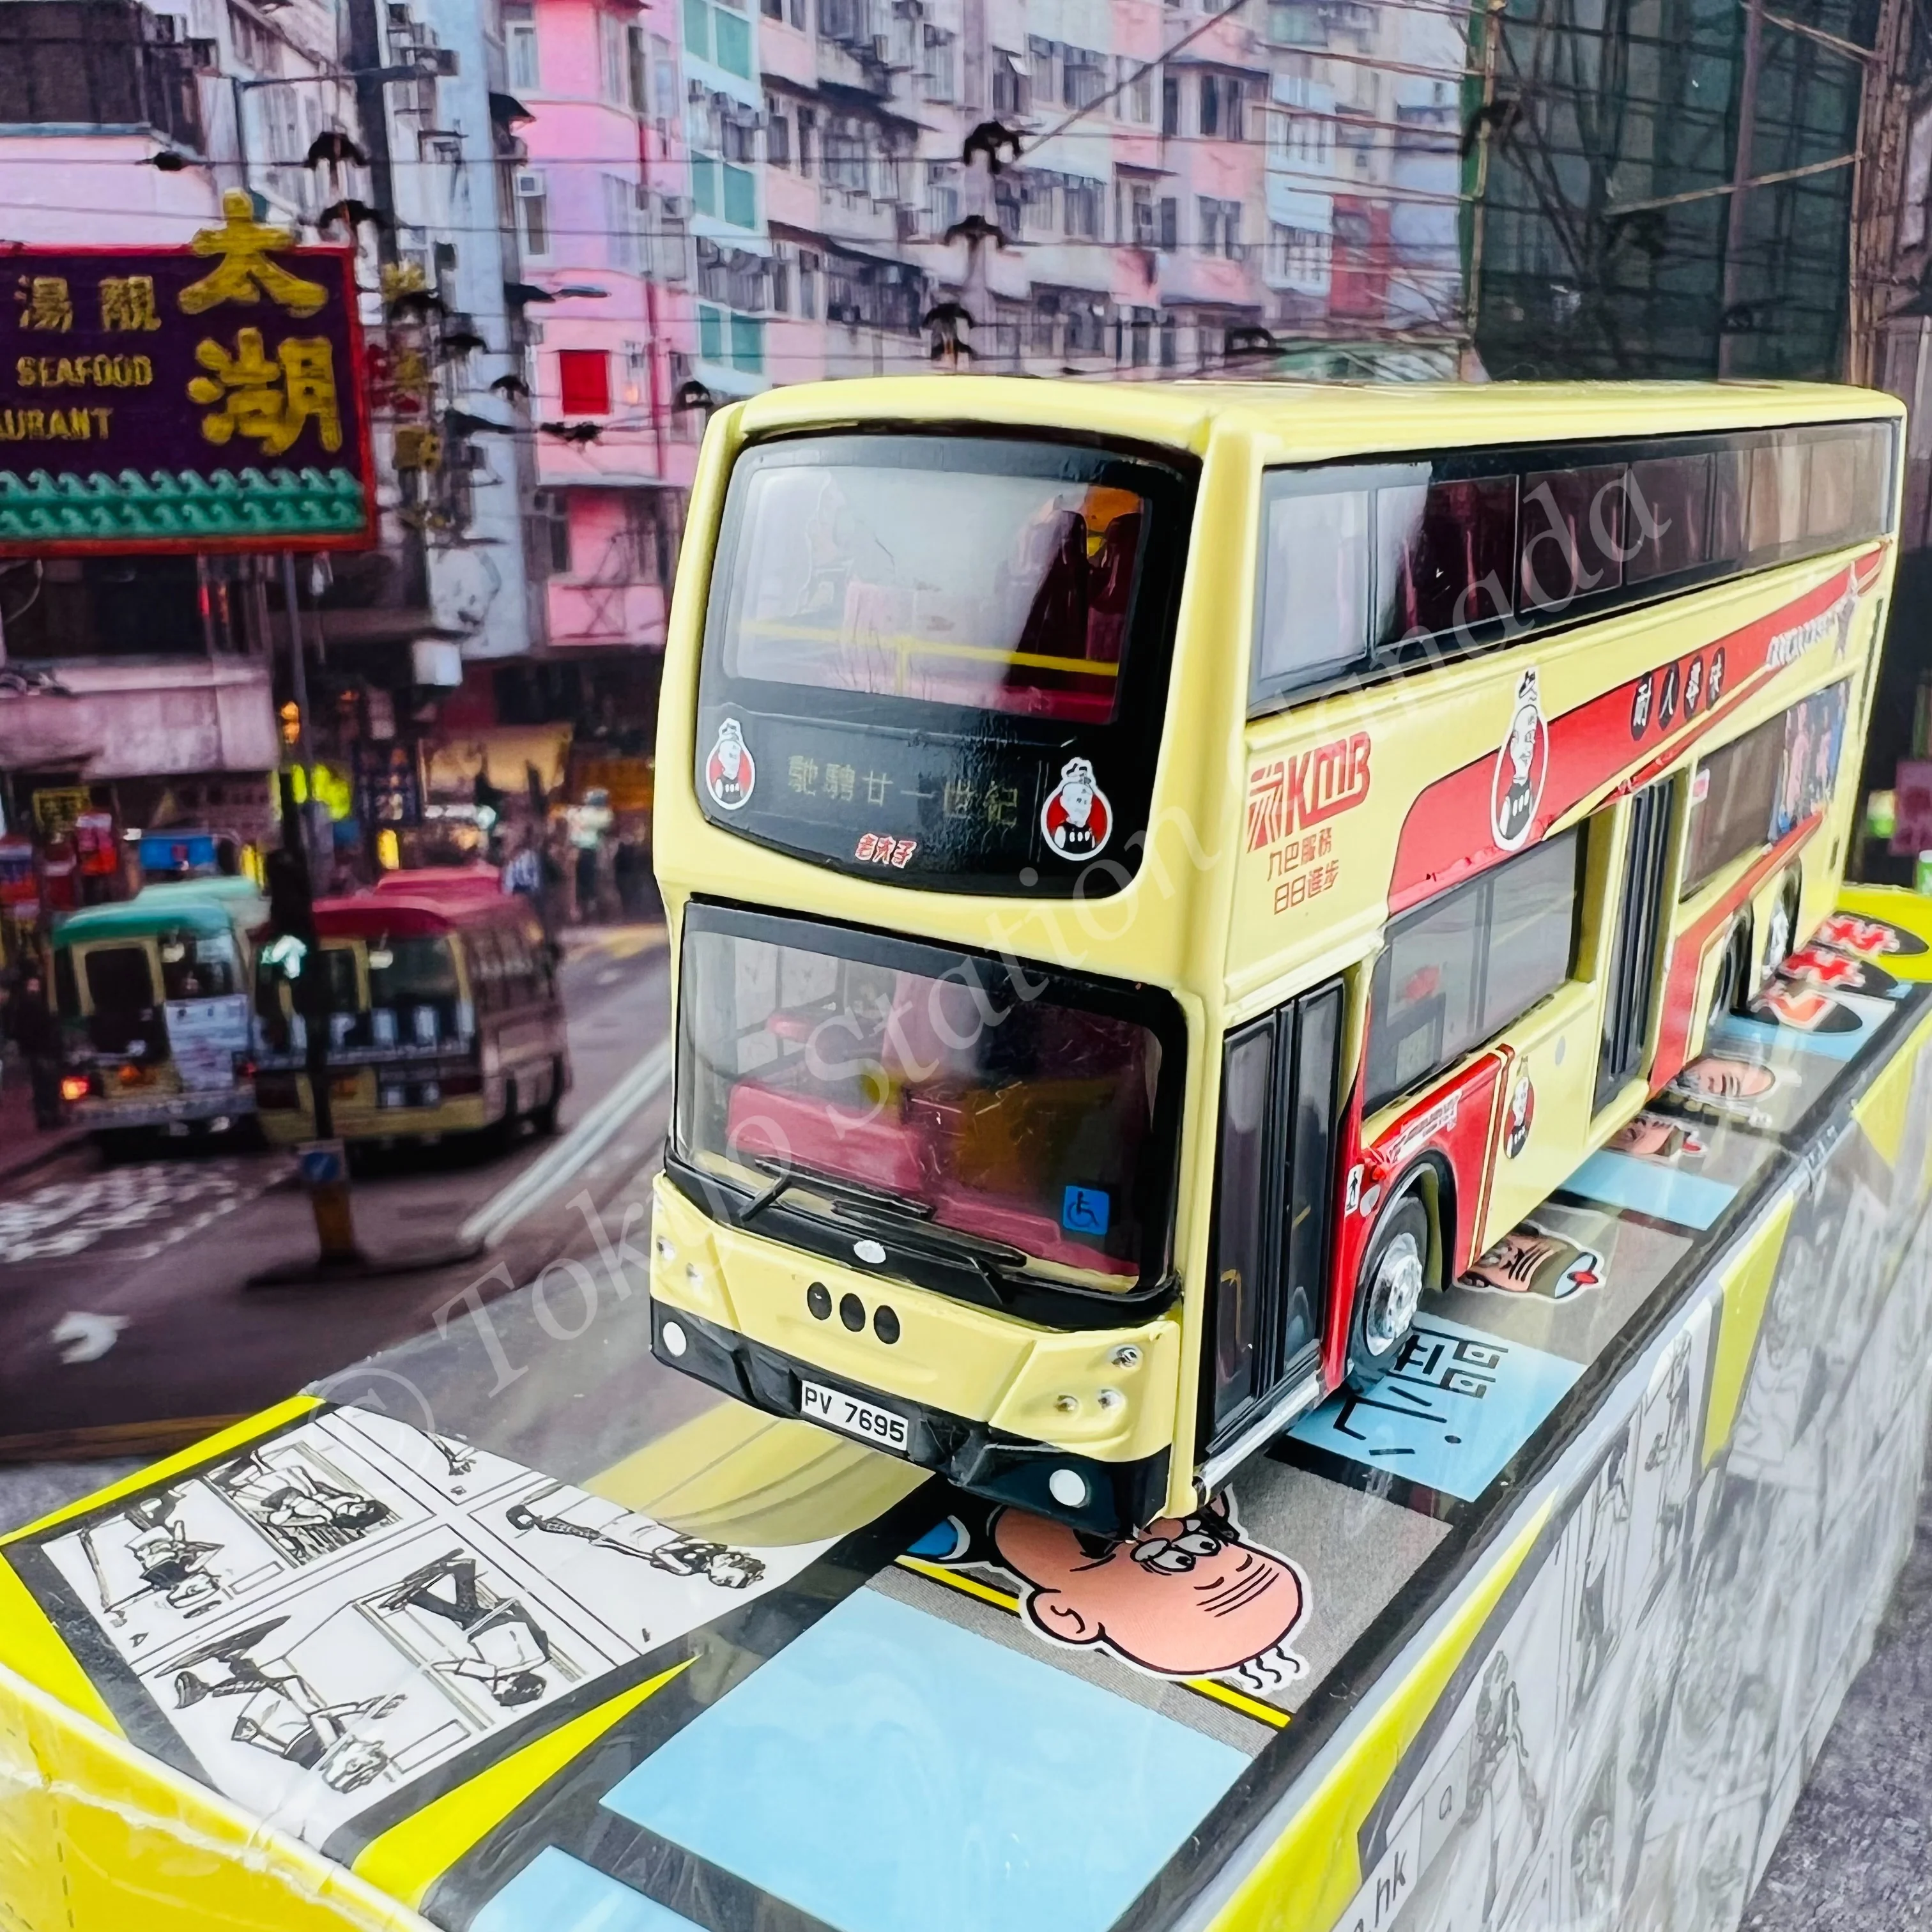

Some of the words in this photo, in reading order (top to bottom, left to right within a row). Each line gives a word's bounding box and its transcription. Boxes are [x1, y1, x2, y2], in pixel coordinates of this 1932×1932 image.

[16, 353, 153, 388] SEAFOOD
[1267, 827, 1333, 882] 九巴服務
[1273, 859, 1339, 916] 日日進步
[805, 1386, 832, 1414] PV
[845, 1401, 905, 1443] 7695
